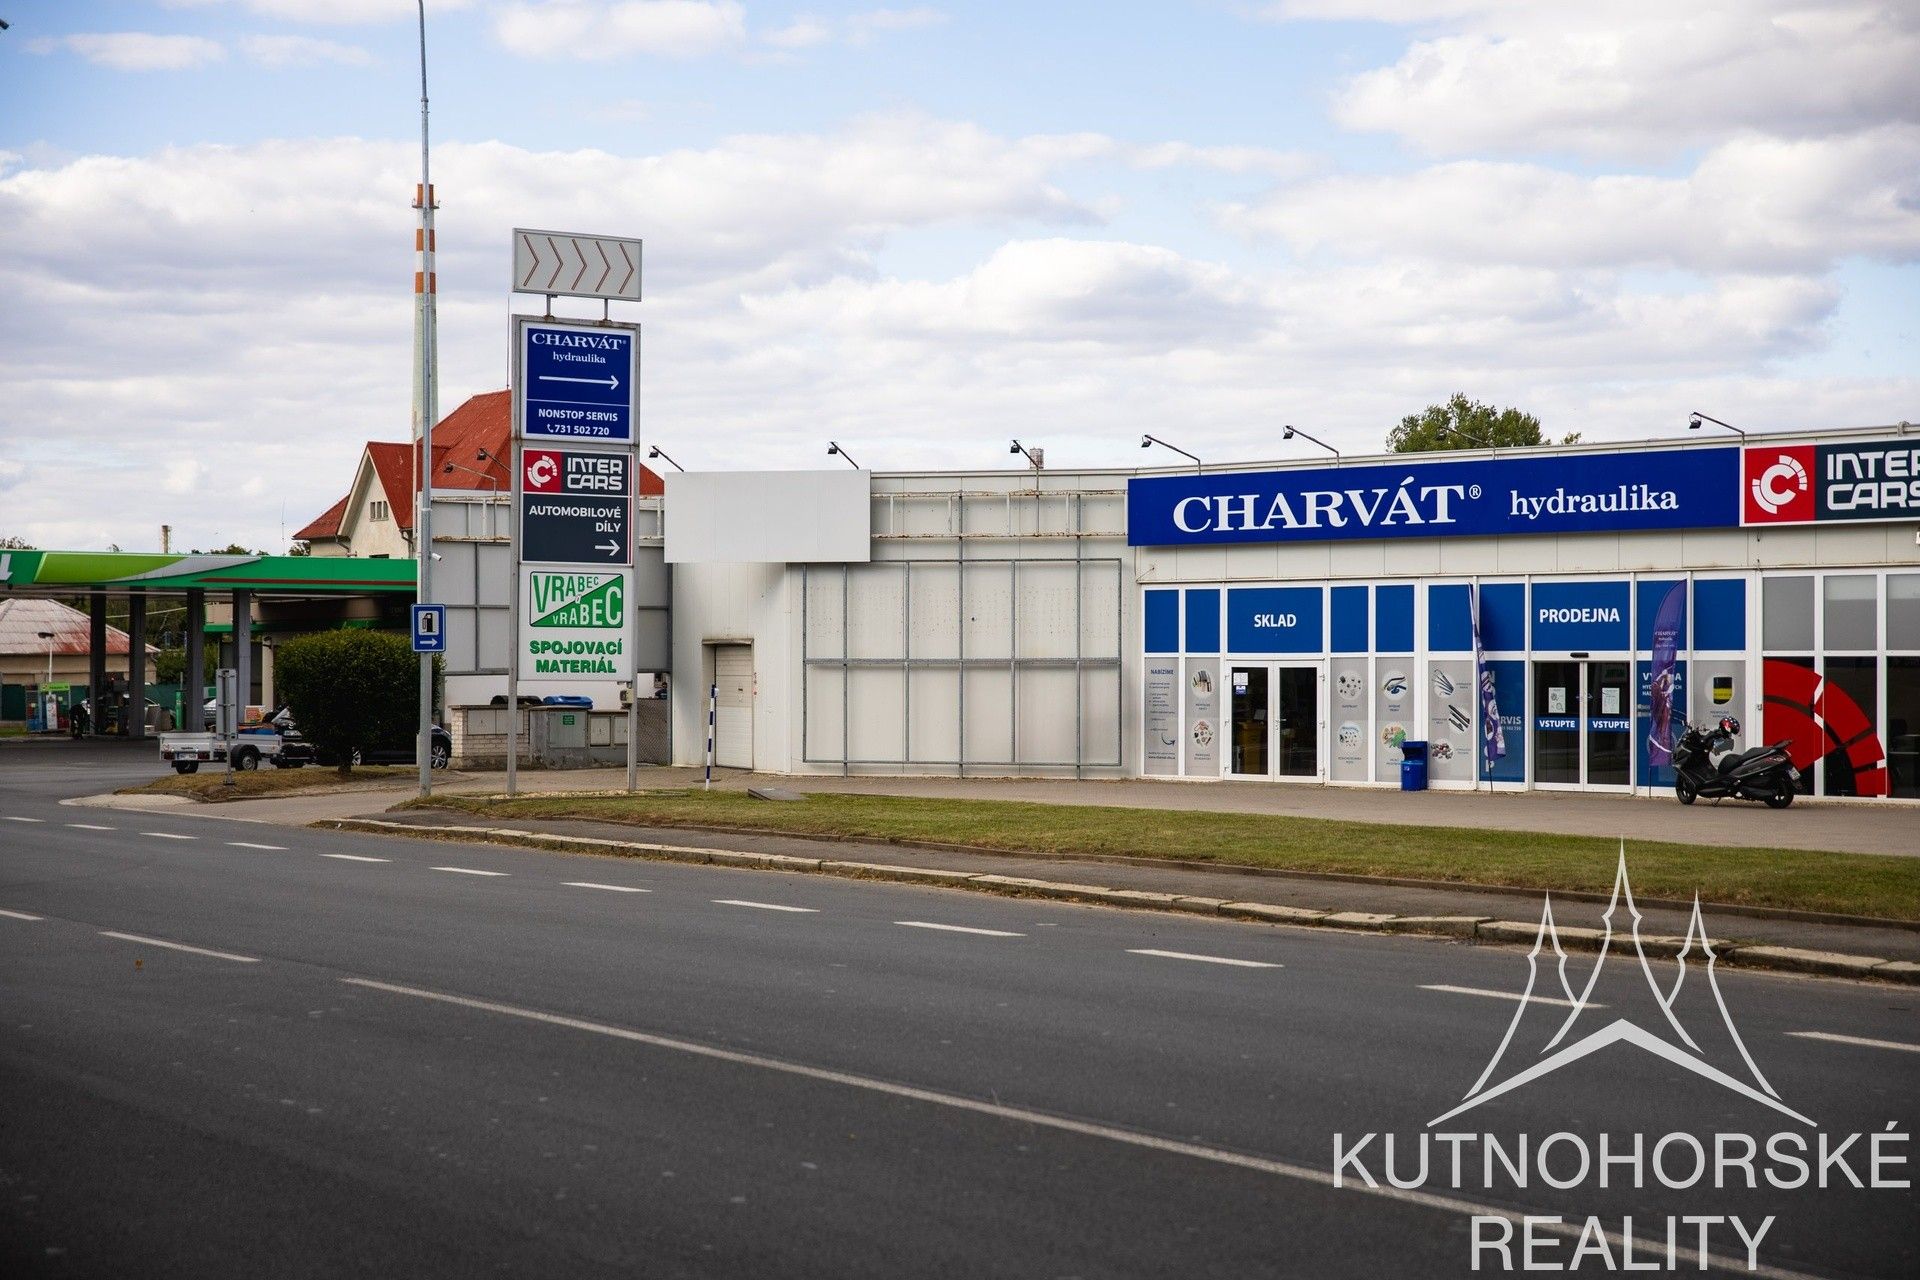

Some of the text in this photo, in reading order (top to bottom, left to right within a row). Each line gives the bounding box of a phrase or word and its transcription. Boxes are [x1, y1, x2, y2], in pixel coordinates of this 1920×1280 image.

[553, 351, 606, 363] hydraulika
[538, 409, 618, 421] NONSTOP SERVIS
[555, 425, 609, 435] 731 502 720
[567, 457, 622, 474] INTER
[567, 474, 622, 490] CARS
[1510, 484, 1679, 519] hydraulika
[529, 505, 621, 518] AUTOMOBILOVÉ
[595, 520, 621, 532] DÍLY
[533, 575, 599, 613] VRABEC
[1254, 614, 1296, 627] SKLAD
[1540, 608, 1620, 623] PRODEJNA
[530, 638, 622, 655] SPOJOVACÍ
[536, 656, 616, 673] MATERIÁL
[1539, 720, 1575, 728] VSTUPTE
[1592, 721, 1629, 729] VSTUPTE
